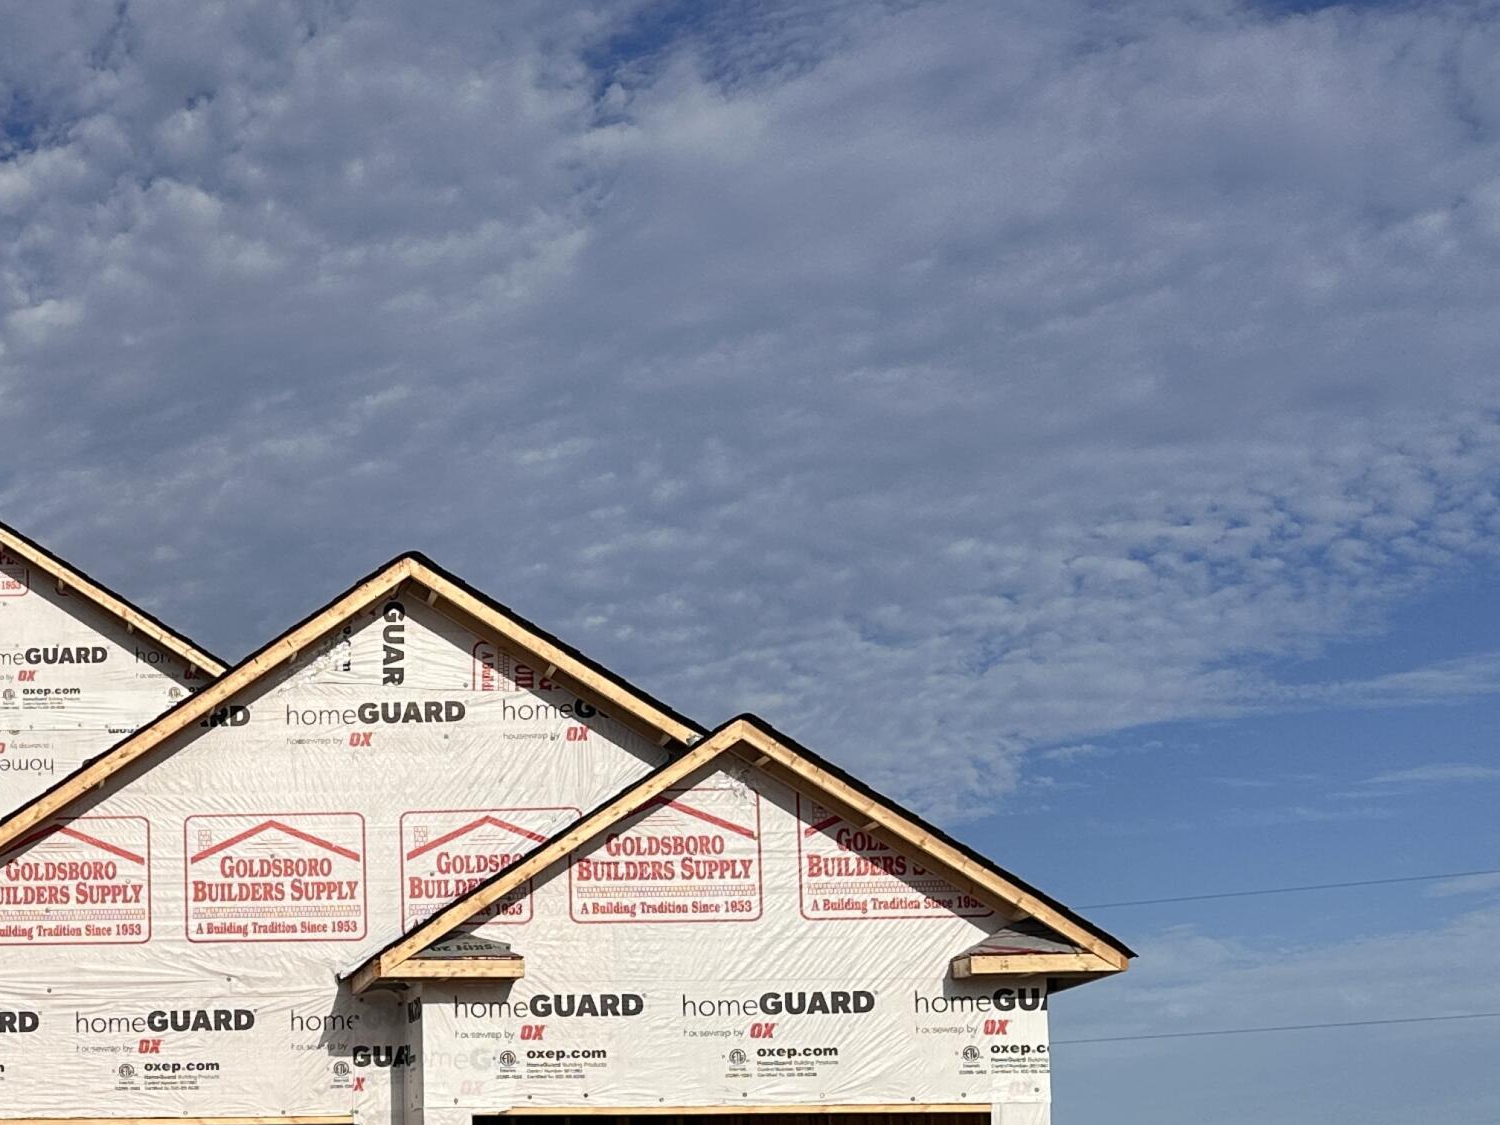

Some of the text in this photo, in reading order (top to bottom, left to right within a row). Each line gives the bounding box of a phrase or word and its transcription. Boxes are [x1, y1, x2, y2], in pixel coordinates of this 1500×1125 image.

[17, 670, 36, 682] OX
[22, 686, 81, 697] oxep.com
[286, 700, 466, 725] homeGUARD
[349, 731, 374, 747] OX
[566, 725, 589, 742] OX
[606, 833, 725, 856] GOLDSBORO
[6, 859, 117, 881] GOLDSBORO
[220, 856, 332, 878] GOLDSBORO
[577, 857, 753, 881] BUILDERS SUPPLY
[807, 854, 906, 878] BUILDERS
[75, 882, 143, 904] SUPPLY
[192, 878, 358, 902] BUILDERS SUPPLY
[581, 900, 752, 918] A Building Tradition Since 1953
[811, 899, 820, 911] A
[823, 898, 868, 914] Building
[871, 896, 920, 911] Tradition
[924, 895, 953, 910] Since
[36, 924, 82, 937] Tradition
[85, 923, 112, 937] Since
[115, 923, 142, 936] 1953
[195, 920, 357, 937] A Building Tradition Since 1953
[455, 994, 644, 1018] homeGUARD
[682, 990, 876, 1017] homeGUARD
[76, 1008, 256, 1033] homeGUARD
[983, 1019, 1011, 1036] OX
[519, 1024, 547, 1041] OX
[750, 1022, 777, 1039] OX
[137, 1039, 163, 1054] OX
[526, 1049, 607, 1060] oxep.com
[756, 1047, 838, 1059] oxep.com
[144, 1061, 220, 1073] oxep.com
